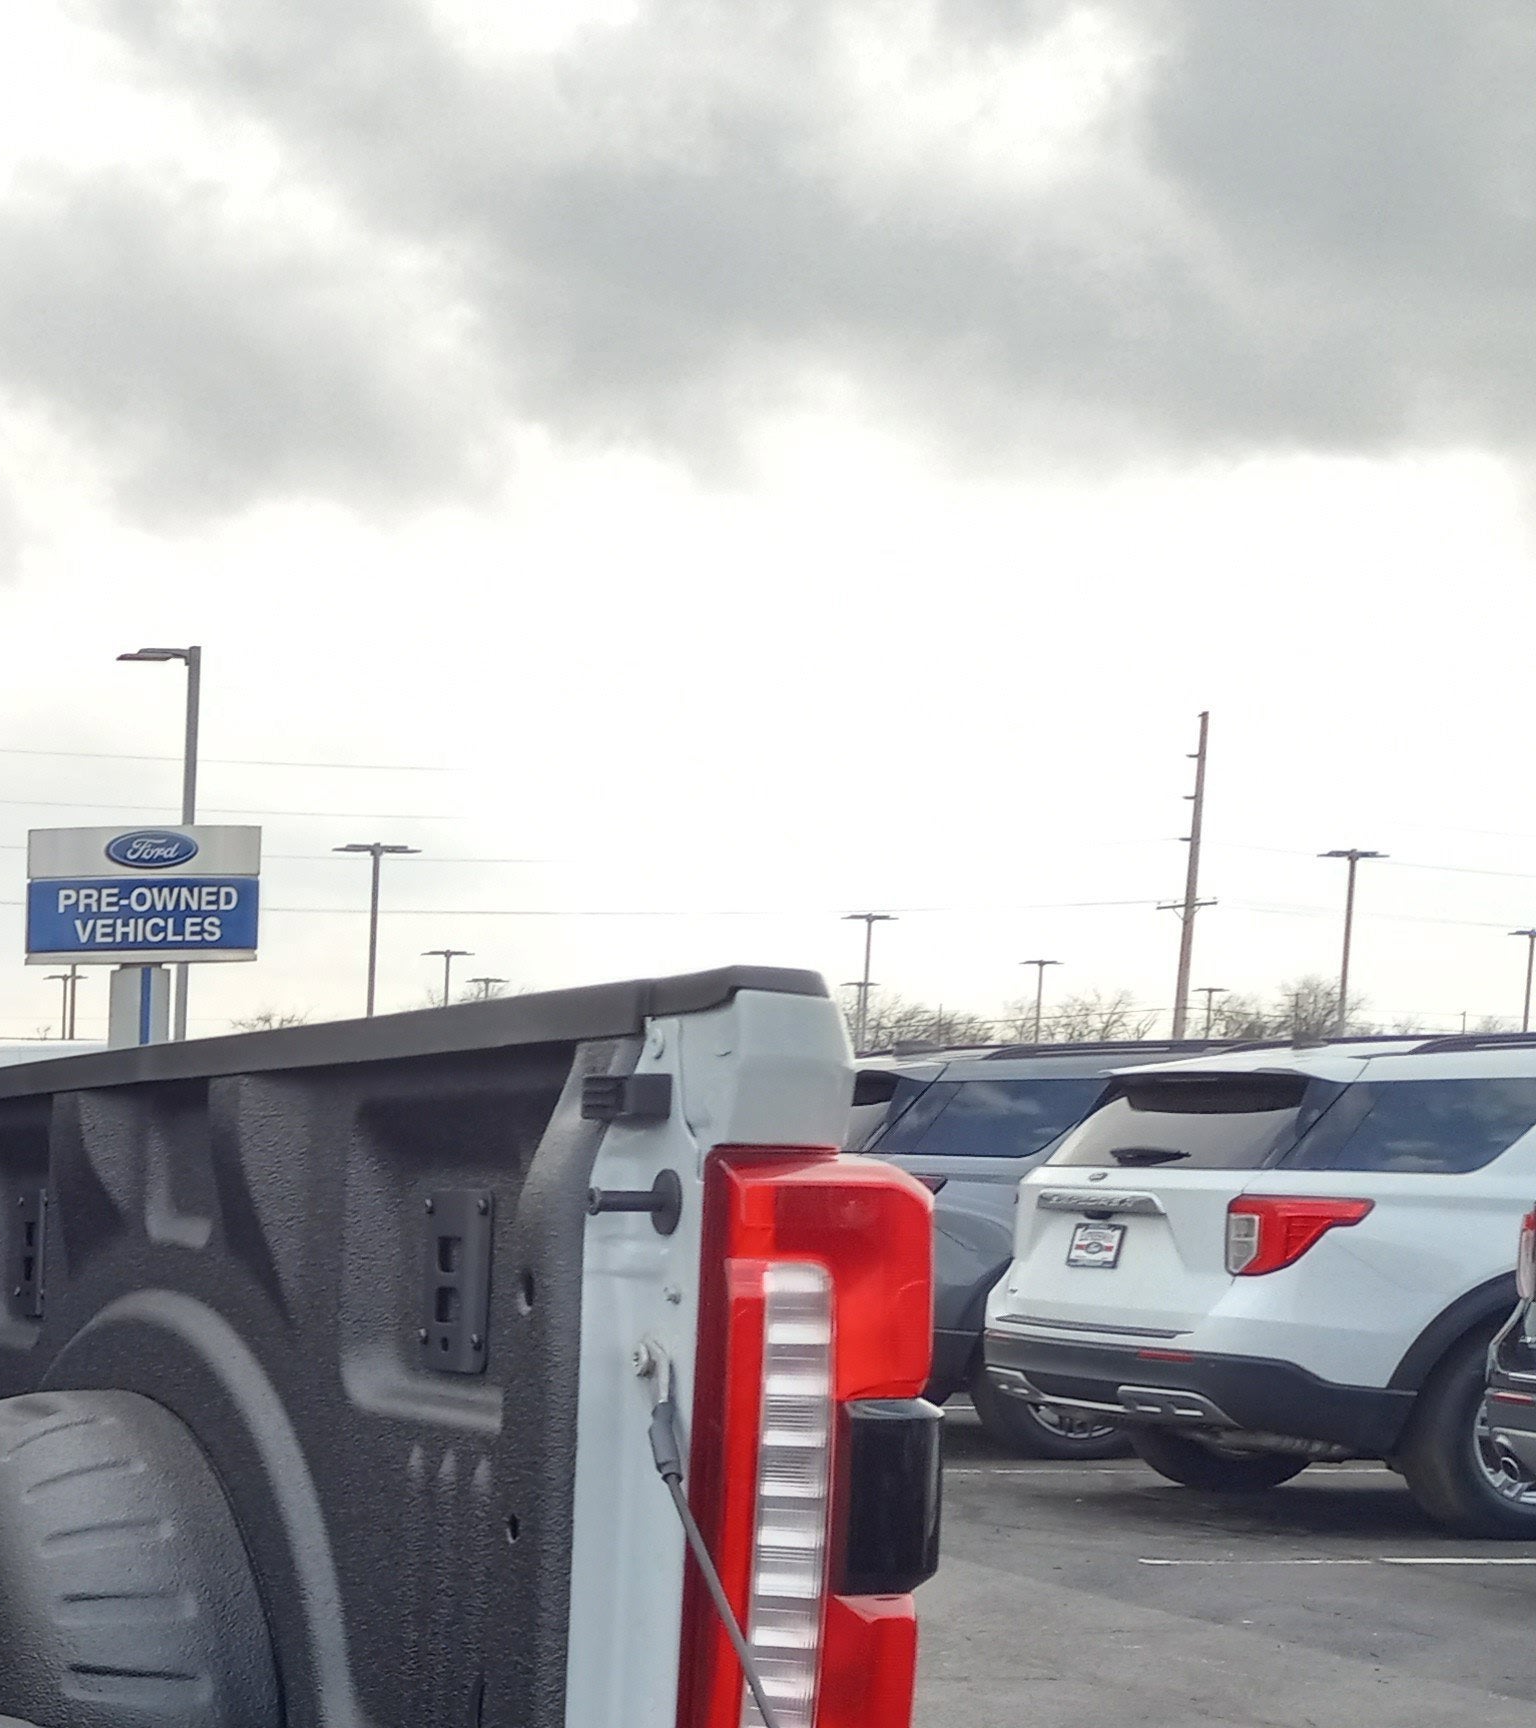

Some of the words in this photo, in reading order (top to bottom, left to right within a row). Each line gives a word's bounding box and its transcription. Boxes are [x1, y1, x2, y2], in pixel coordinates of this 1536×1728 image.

[126, 838, 180, 860] Ford
[58, 887, 237, 913] PRE-OWNED
[75, 917, 221, 942] VEHICLES
